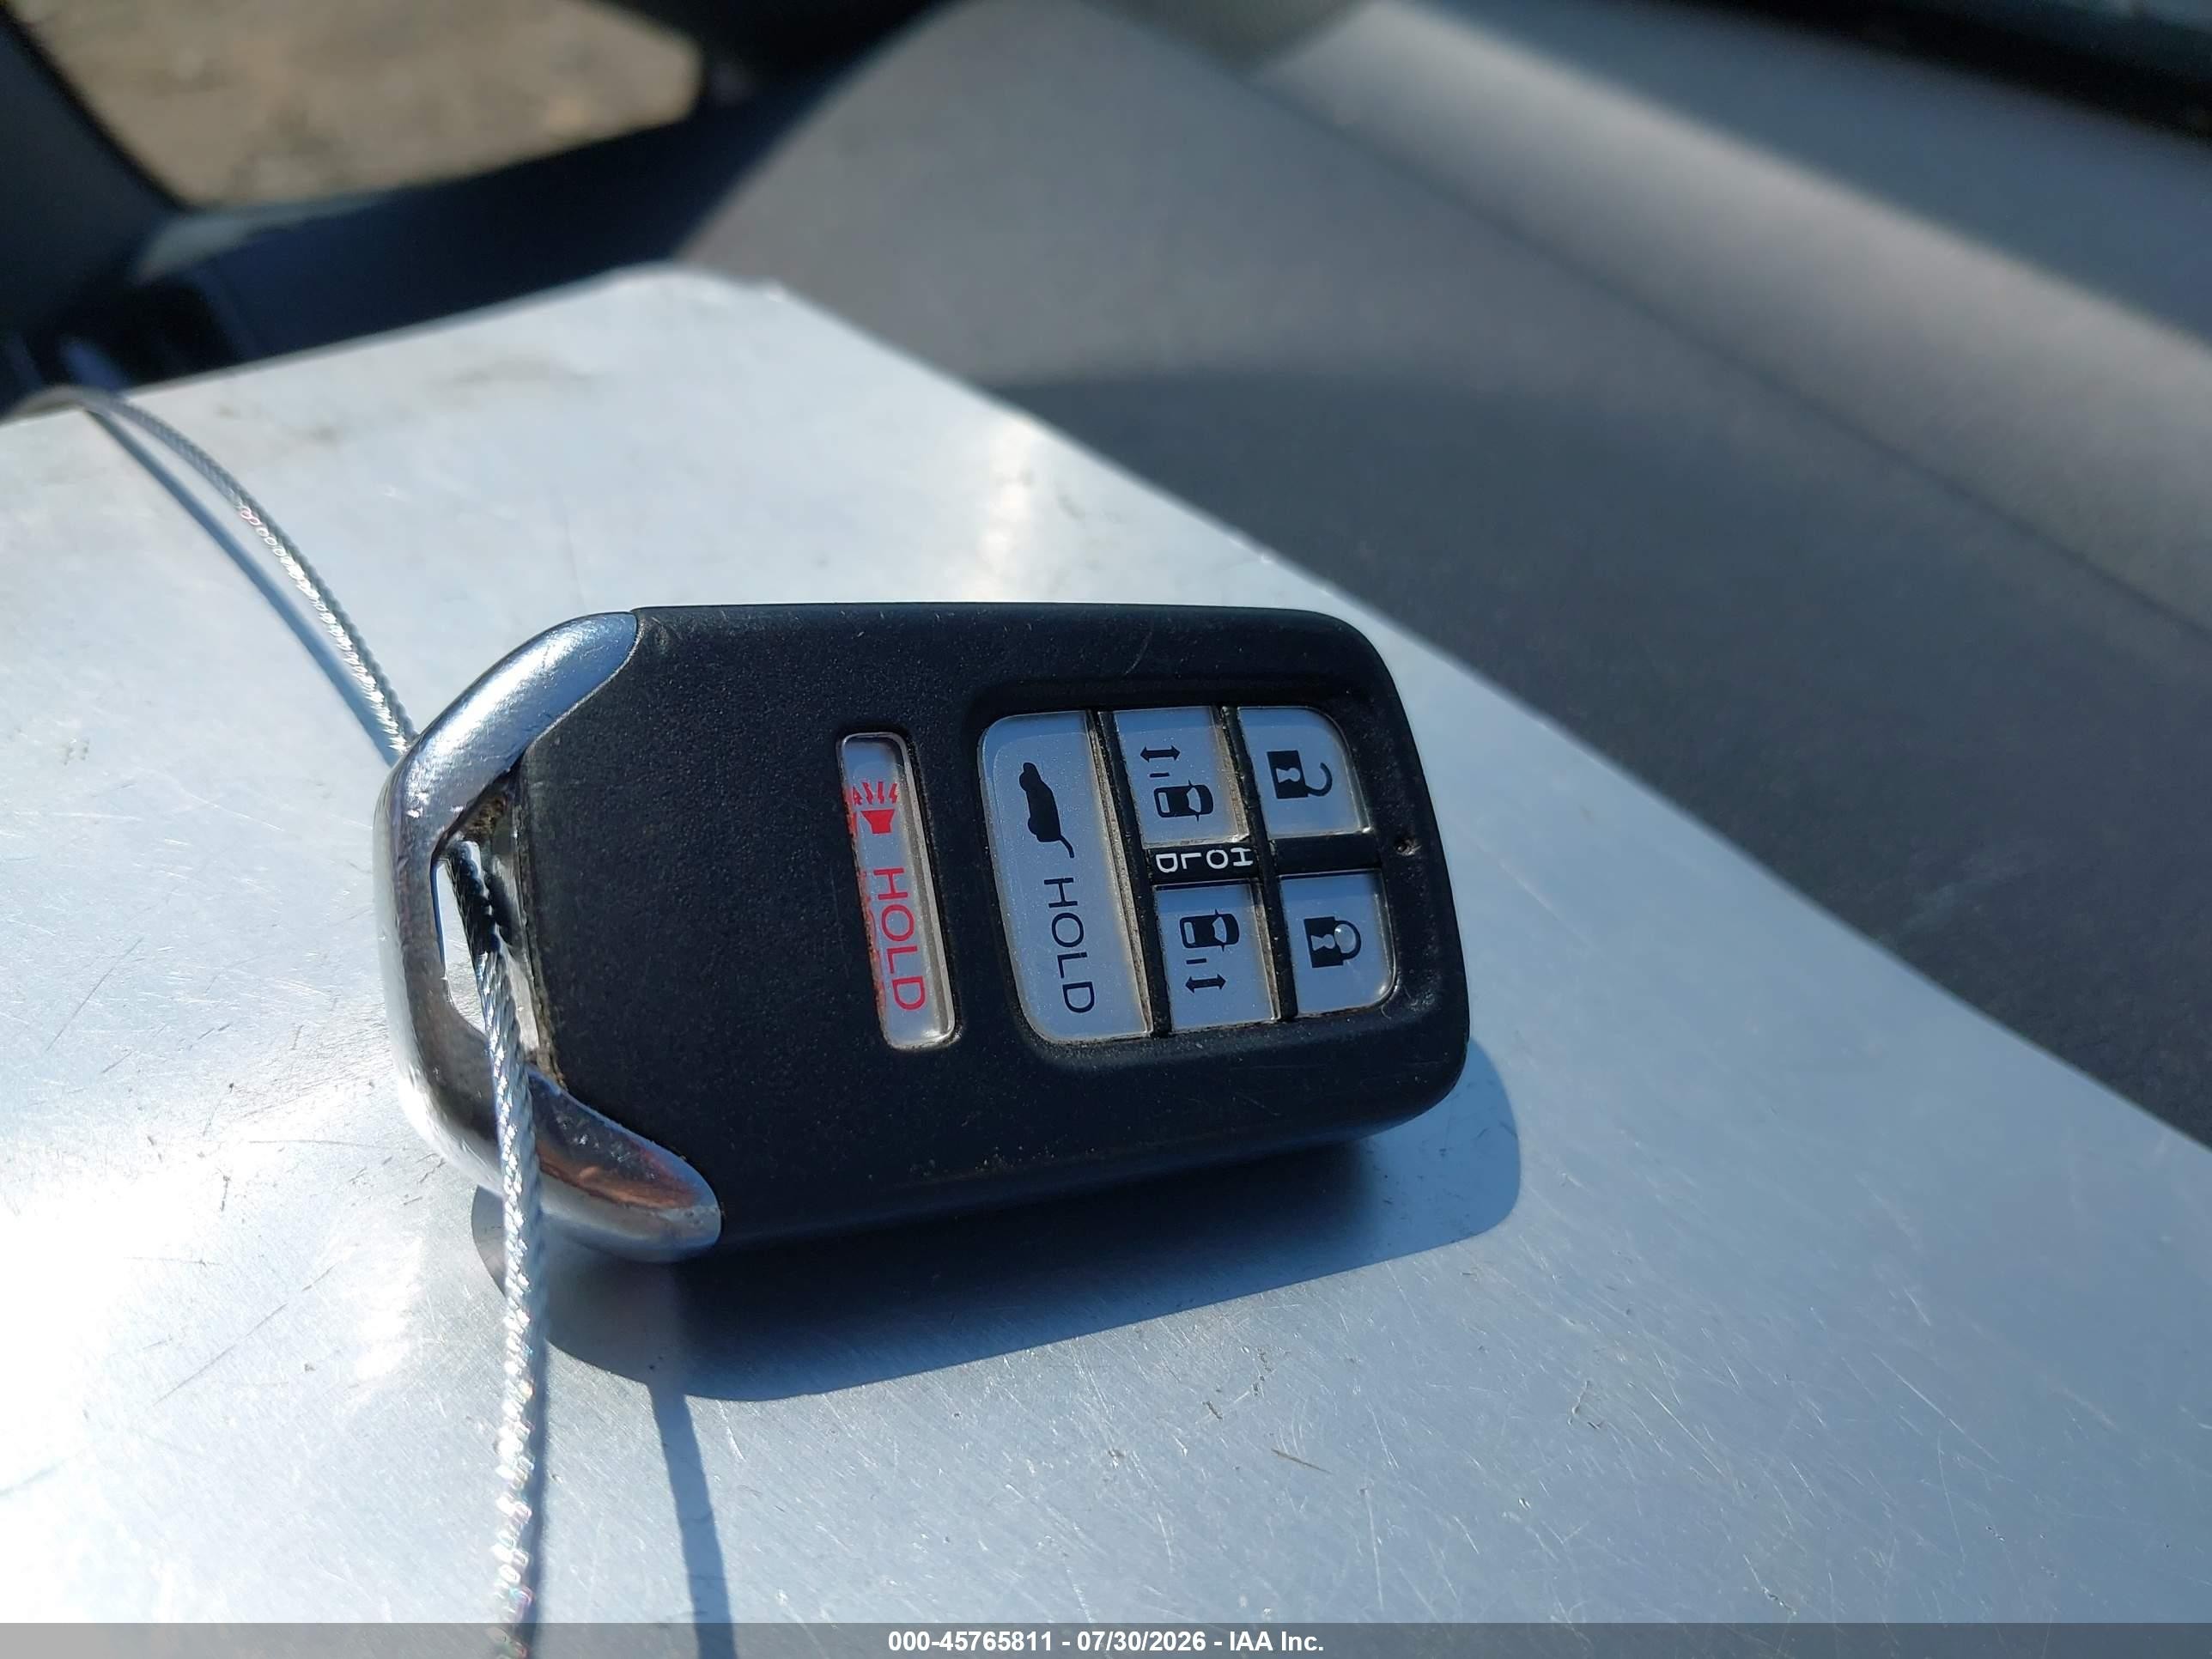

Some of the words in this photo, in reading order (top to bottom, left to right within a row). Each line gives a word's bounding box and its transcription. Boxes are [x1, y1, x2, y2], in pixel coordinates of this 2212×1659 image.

[1156, 847, 1254, 873] HOLD
[873, 867, 927, 1010] HOLD
[1043, 877, 1096, 1014] HOLD
